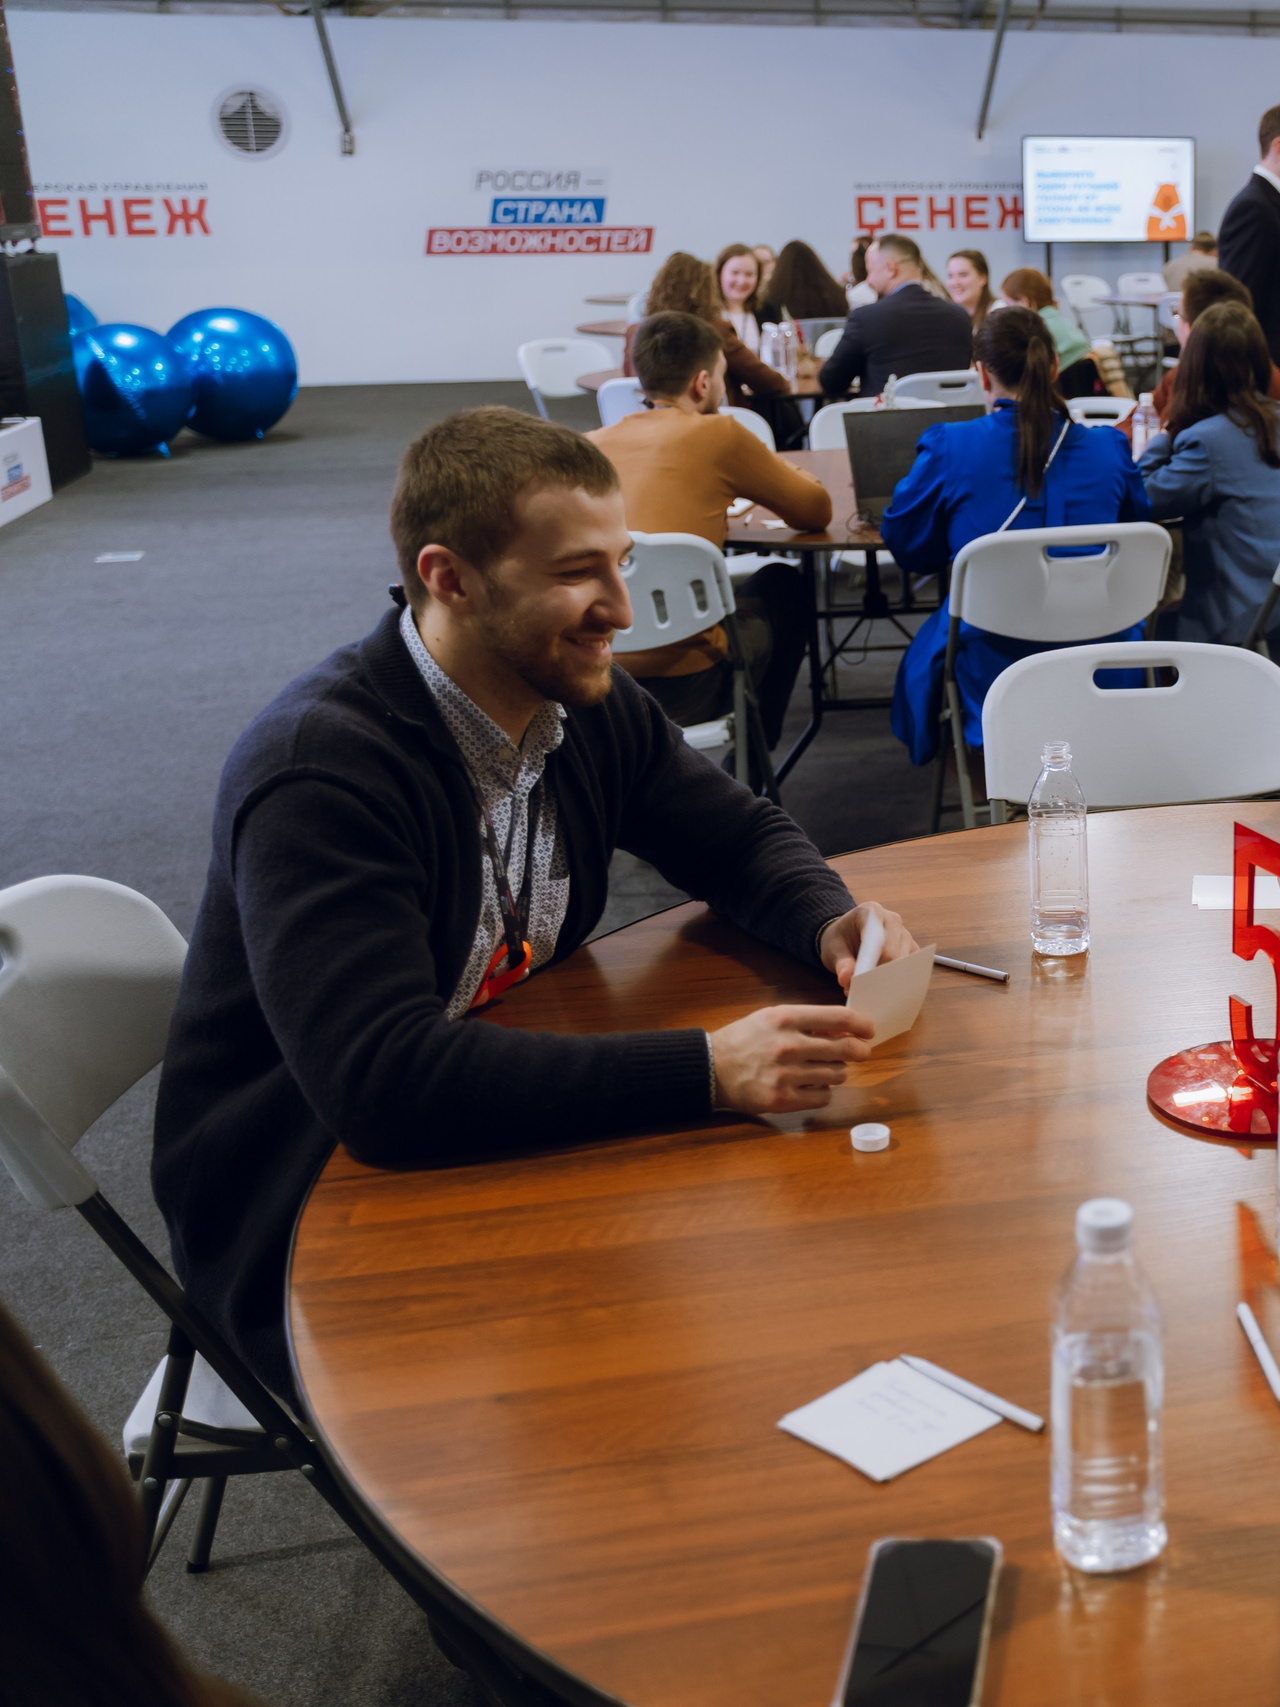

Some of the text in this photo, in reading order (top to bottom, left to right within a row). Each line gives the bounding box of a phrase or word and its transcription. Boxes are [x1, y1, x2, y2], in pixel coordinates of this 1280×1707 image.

[475, 170, 581, 191] РОССИЯ
[37, 197, 213, 237] ЕНЕЖ
[494, 200, 598, 224] СТРАНА
[429, 228, 650, 253] ВОЗМОЖНОСТЕЙ
